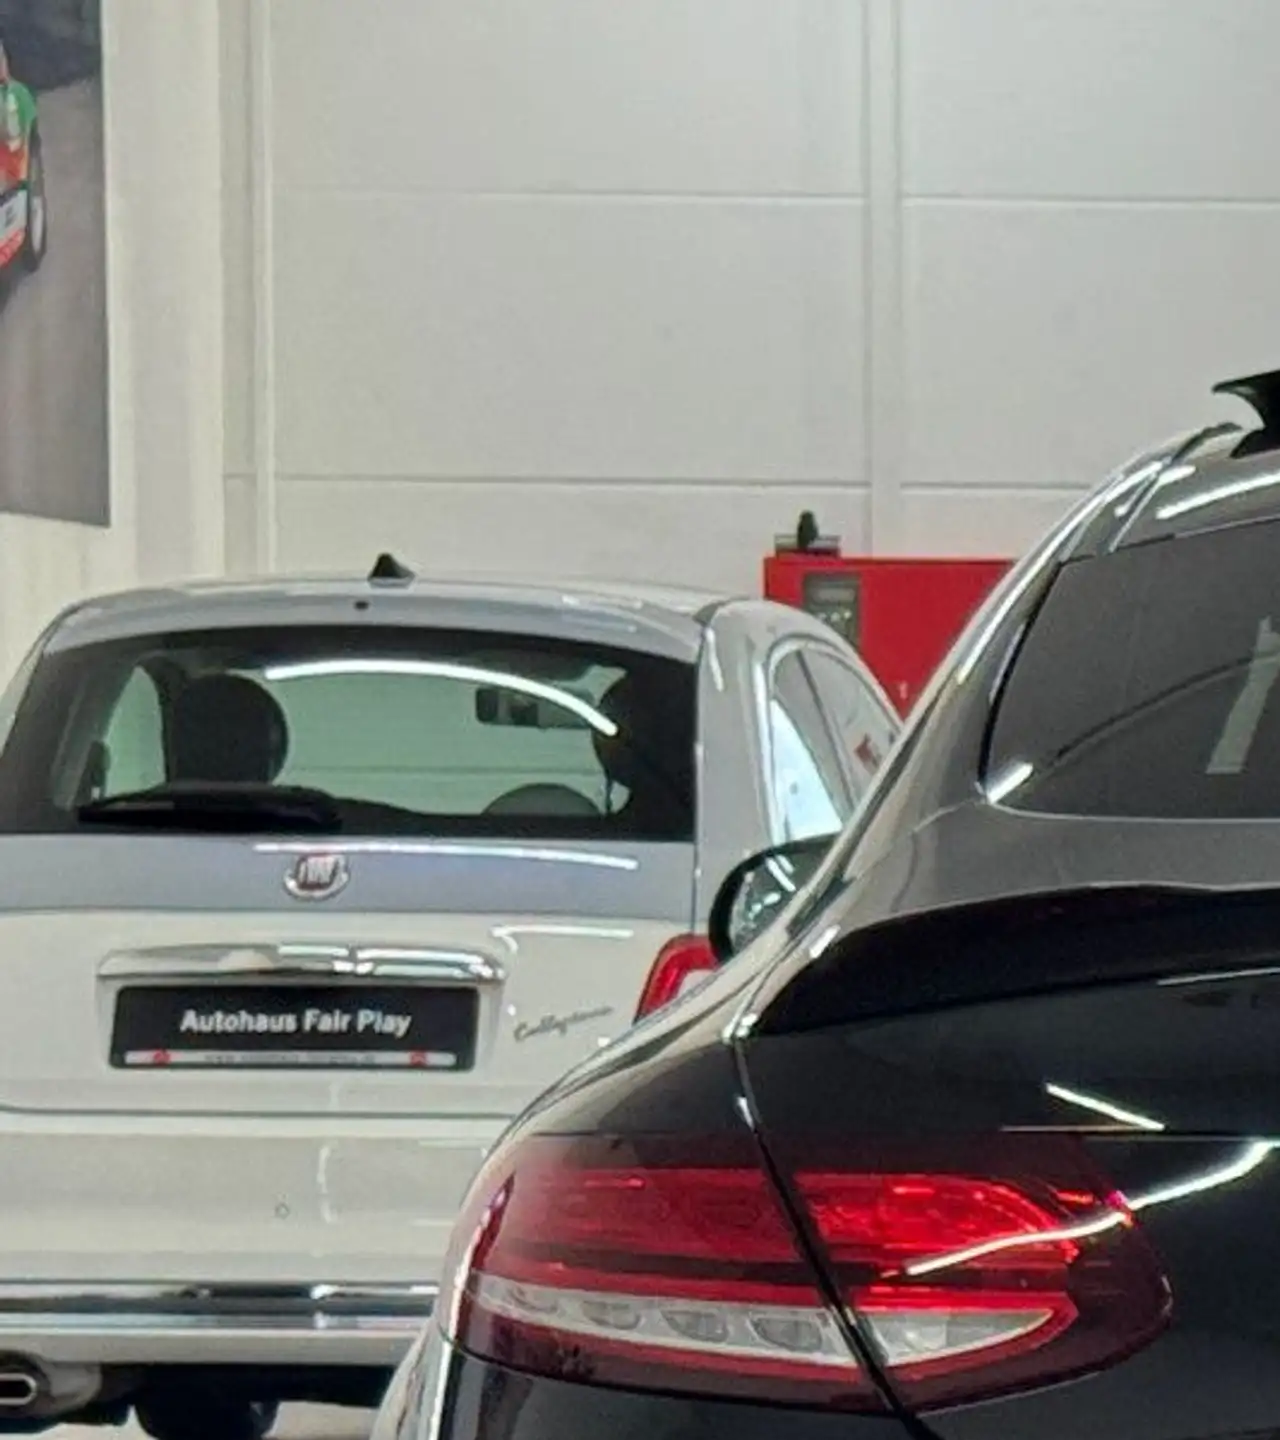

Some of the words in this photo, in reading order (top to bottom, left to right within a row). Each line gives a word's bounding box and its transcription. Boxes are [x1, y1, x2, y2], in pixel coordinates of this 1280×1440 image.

[179, 1008, 298, 1033] Autohaus
[303, 1008, 351, 1033] Fair
[356, 1008, 412, 1040] Play
